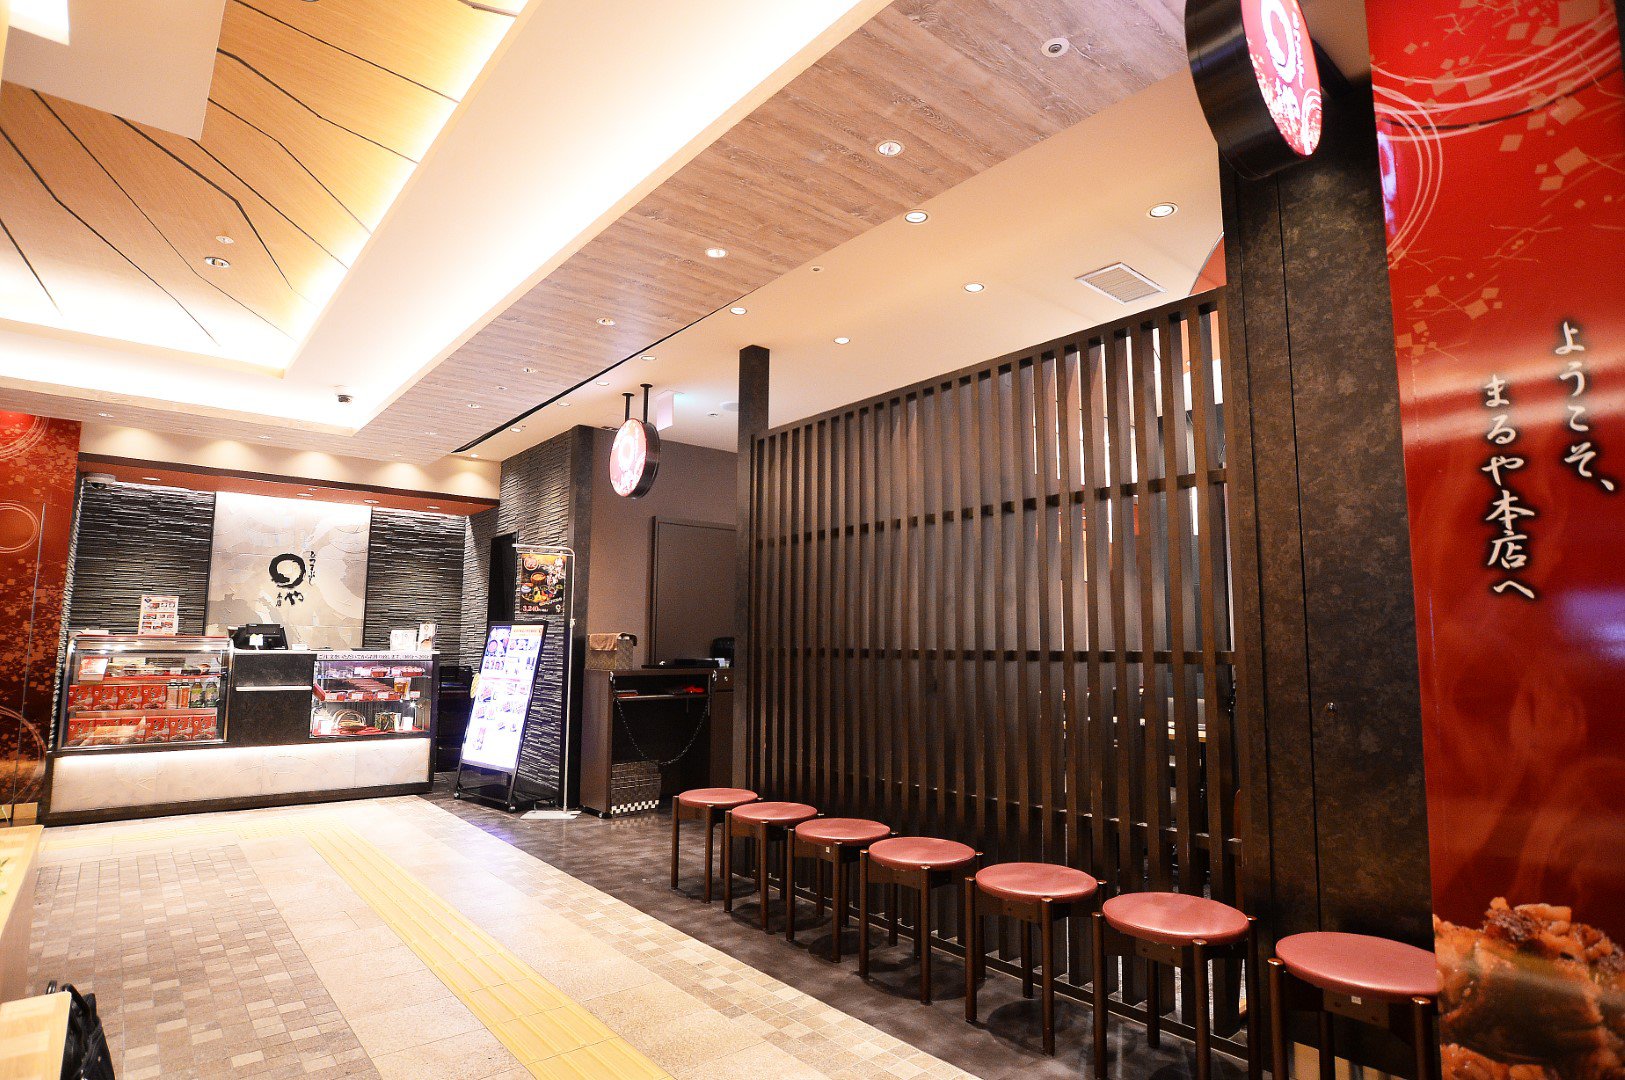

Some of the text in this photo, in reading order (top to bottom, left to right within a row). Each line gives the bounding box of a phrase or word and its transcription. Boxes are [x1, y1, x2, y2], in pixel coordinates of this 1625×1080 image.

[1481, 373, 1536, 600] まるや本店へ
[1555, 321, 1615, 491] ようこそ、
[284, 590, 305, 606] や
